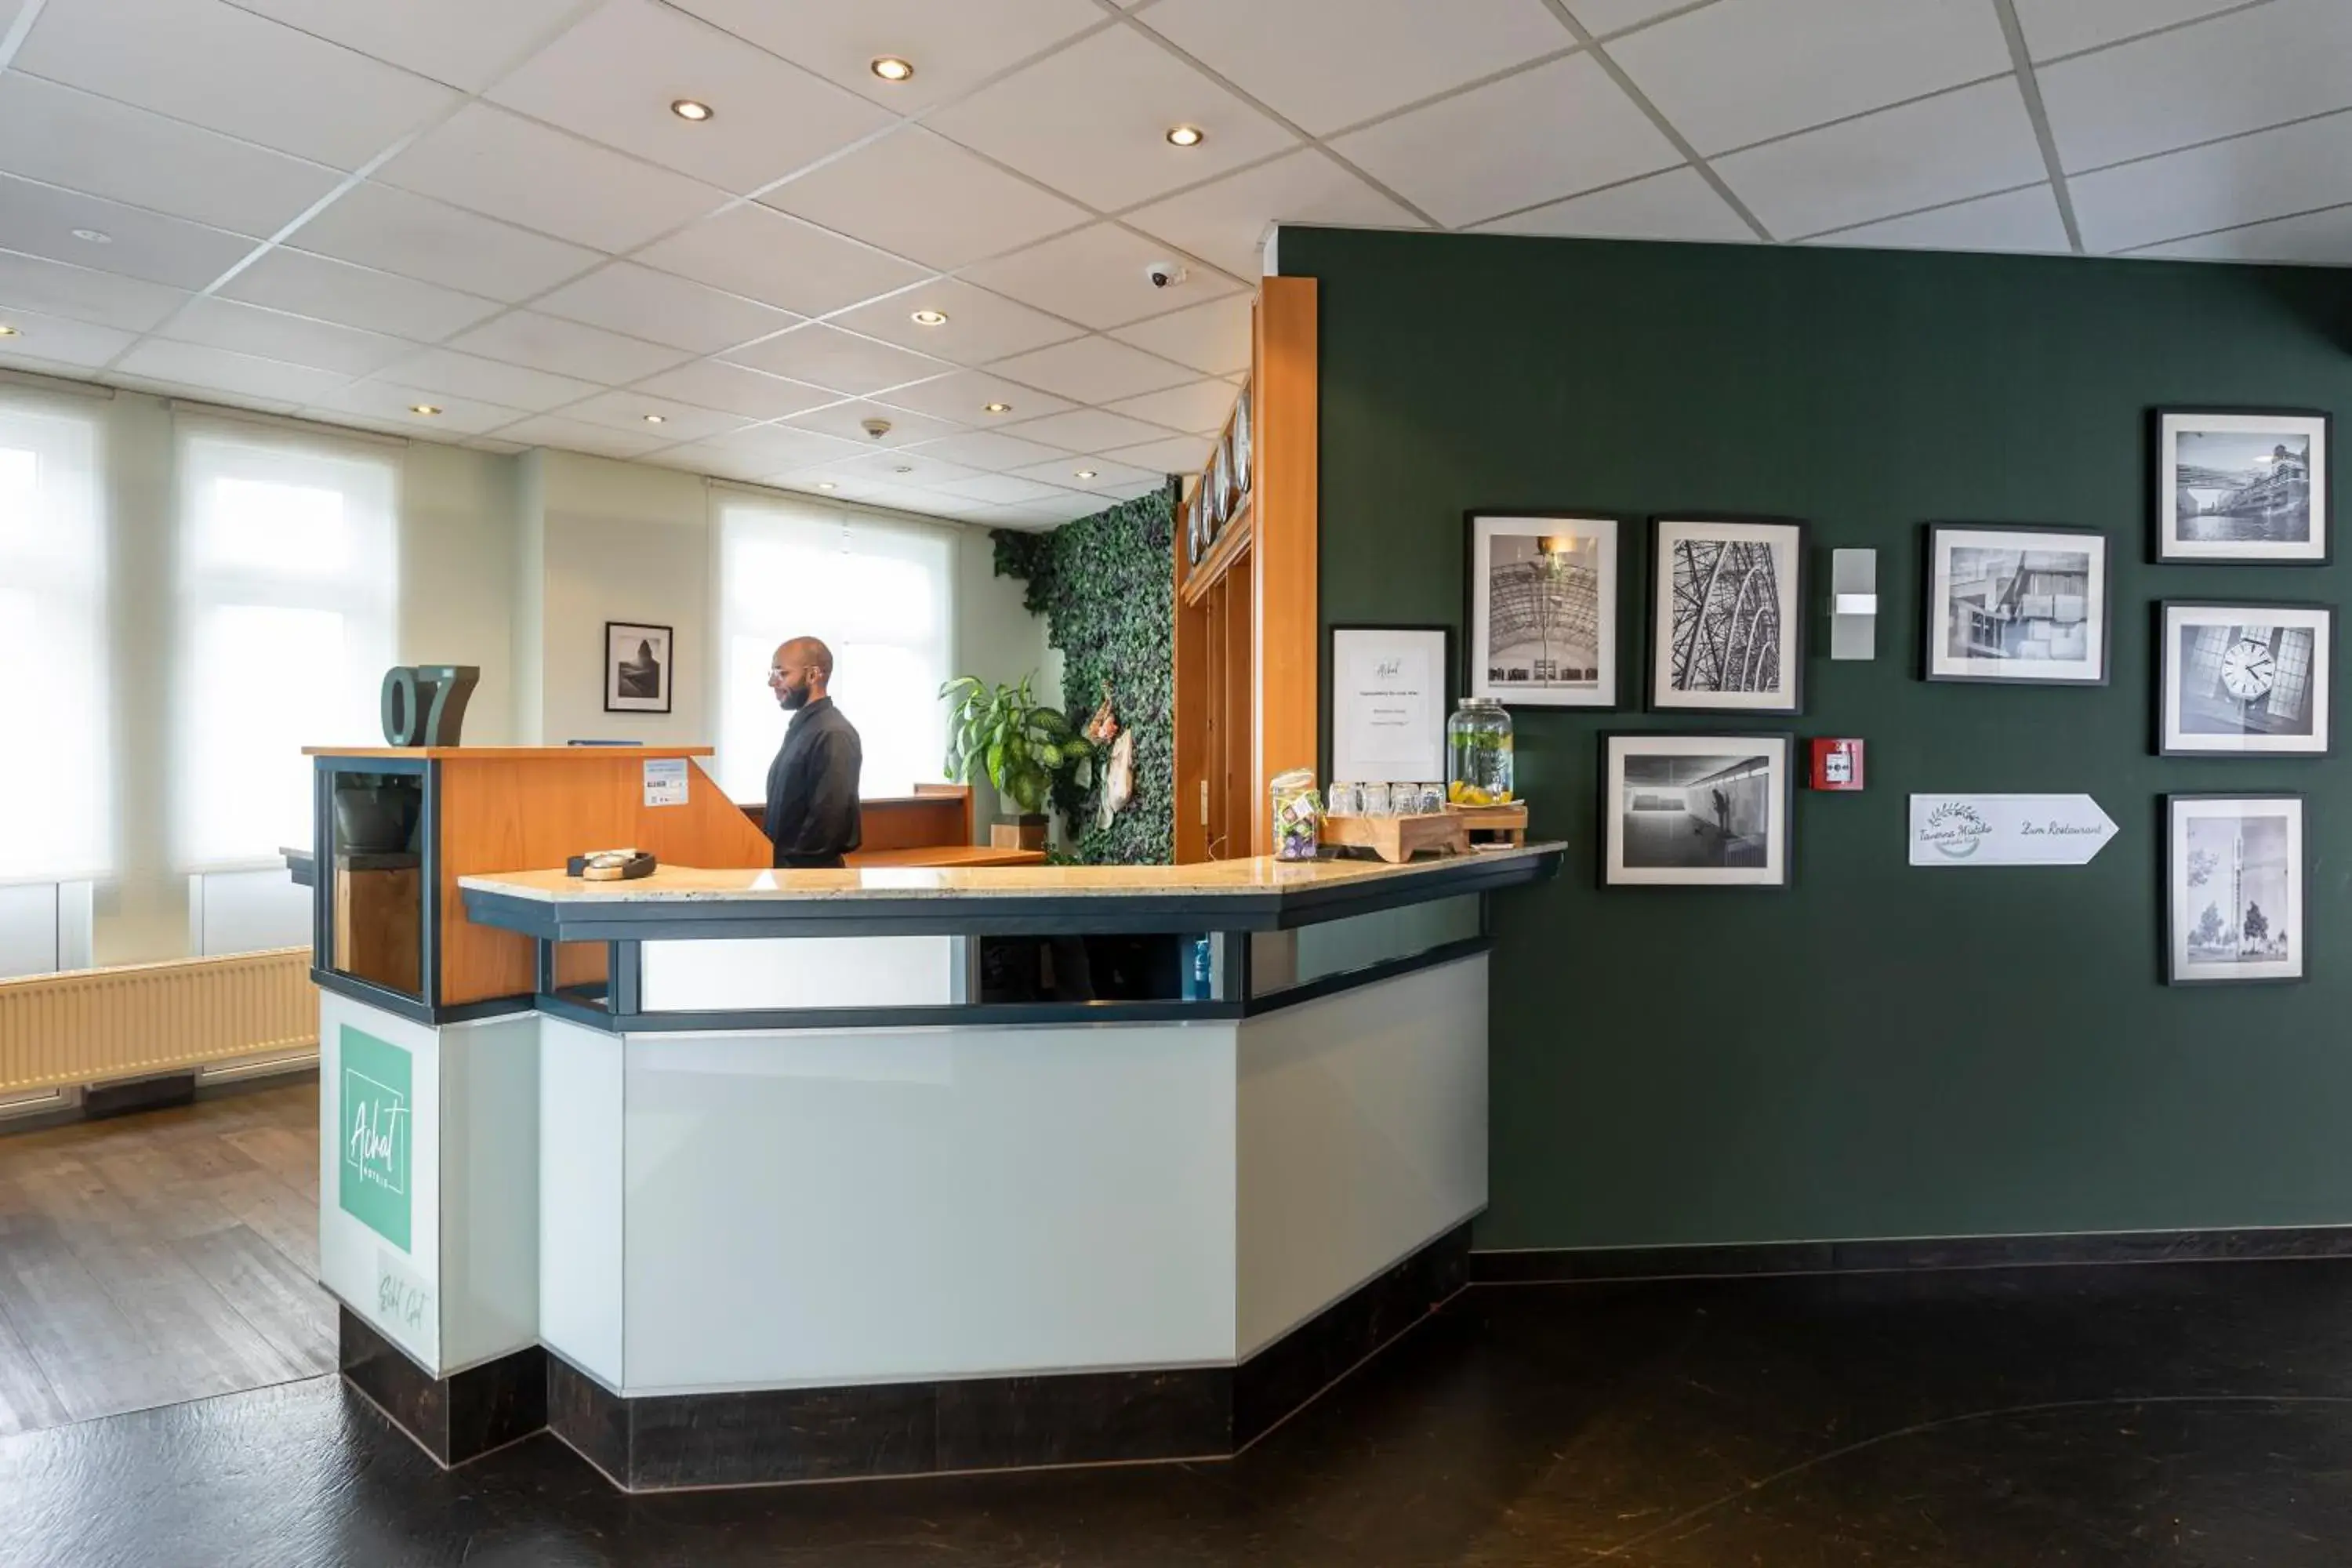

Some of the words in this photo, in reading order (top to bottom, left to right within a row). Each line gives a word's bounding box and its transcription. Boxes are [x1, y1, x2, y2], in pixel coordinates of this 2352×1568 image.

[381, 665, 459, 747] 07
[2020, 820, 2045, 835] Zum
[2047, 819, 2102, 835] Restaurant
[350, 1098, 409, 1182] Achat
